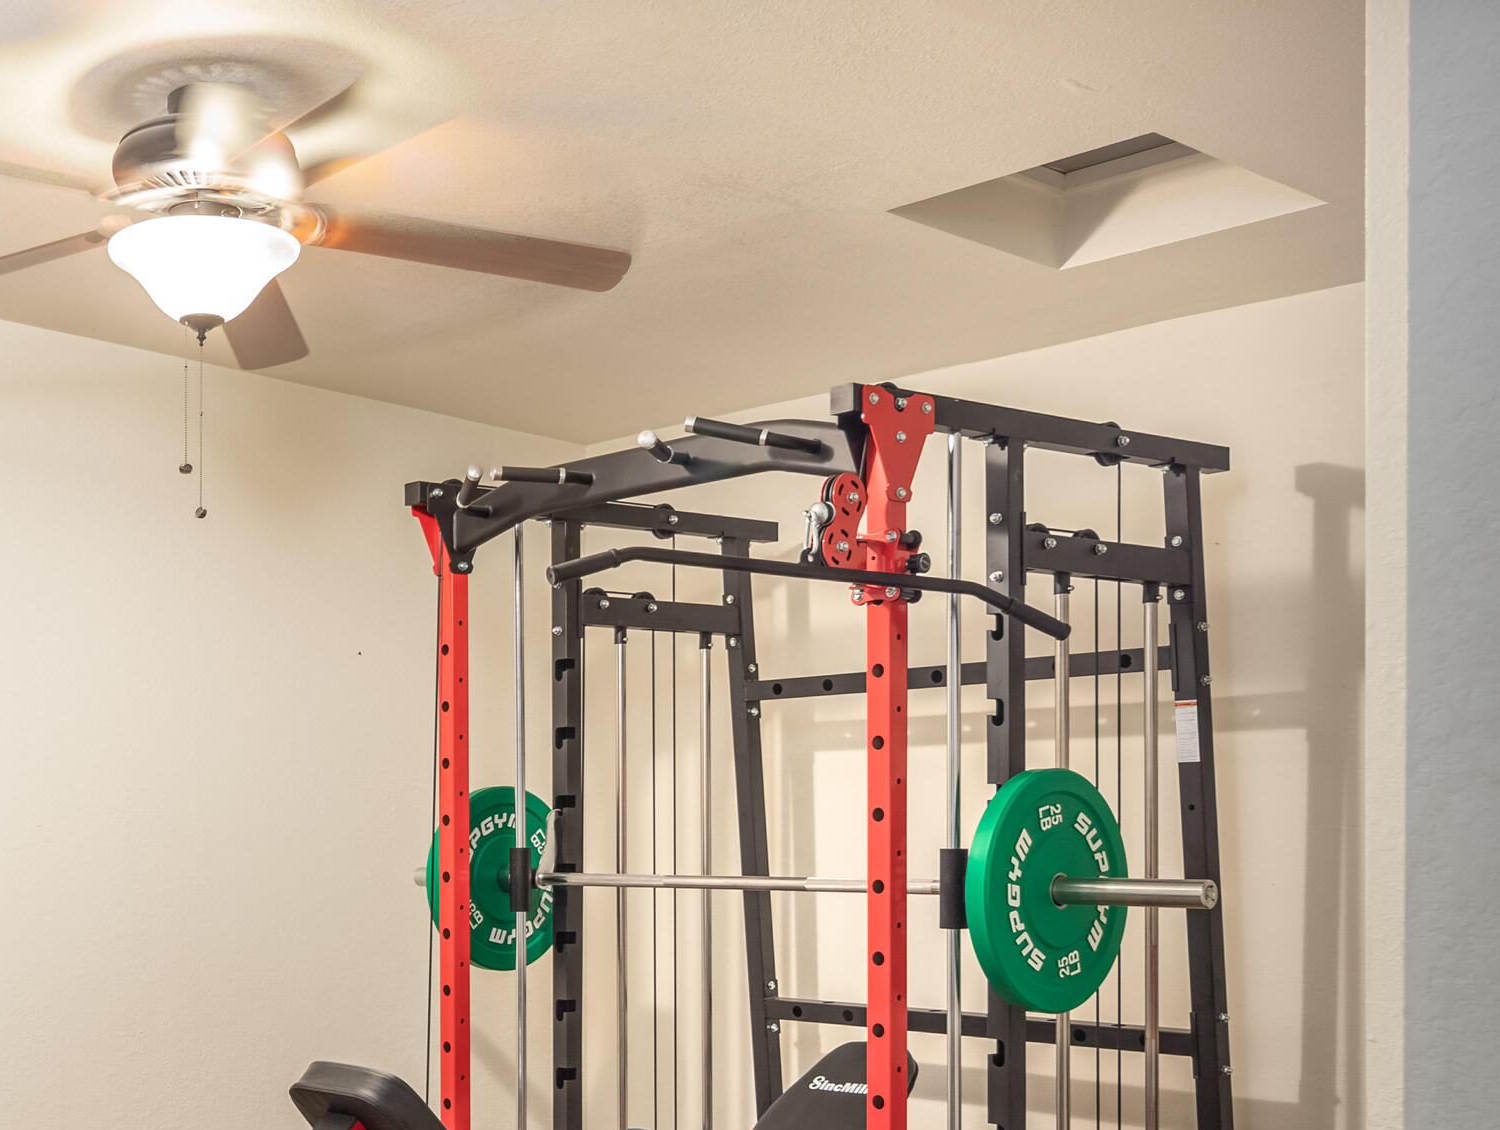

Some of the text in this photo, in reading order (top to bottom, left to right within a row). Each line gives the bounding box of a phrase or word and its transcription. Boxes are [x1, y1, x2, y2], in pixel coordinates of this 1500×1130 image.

[1038, 804, 1052, 831] LB
[1049, 803, 1063, 826] 25
[1007, 828, 1047, 972] SUPGYM
[1057, 956, 1071, 979] 25
[1067, 949, 1082, 976] LB
